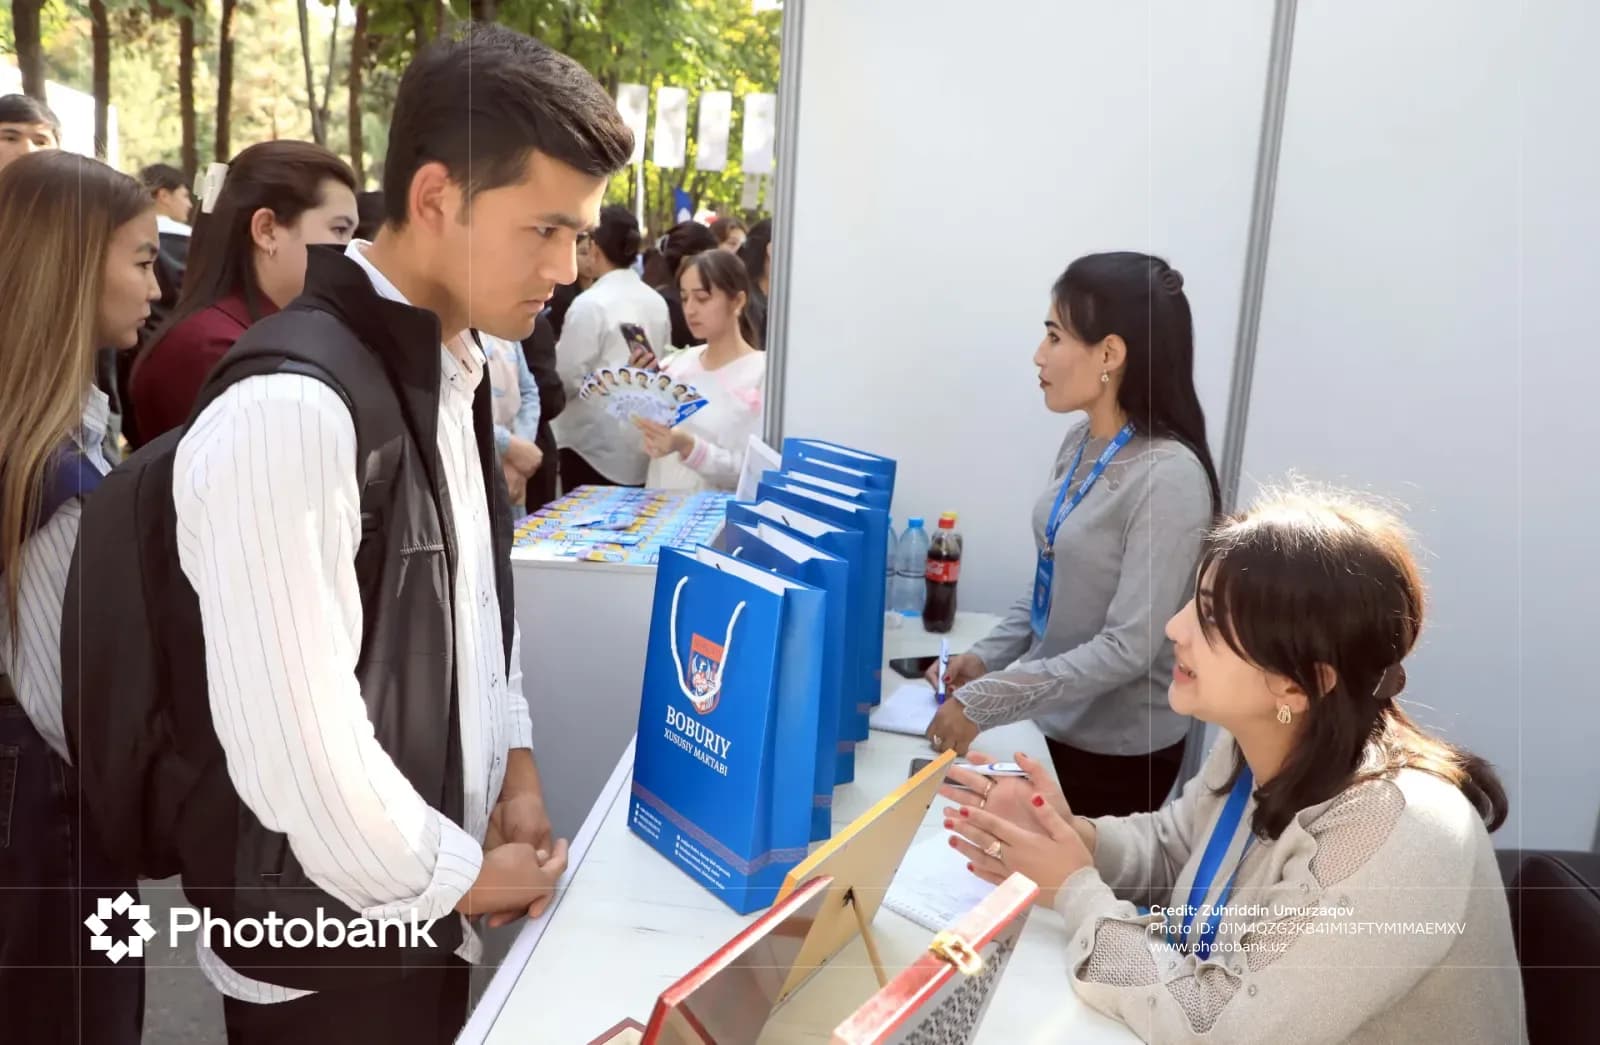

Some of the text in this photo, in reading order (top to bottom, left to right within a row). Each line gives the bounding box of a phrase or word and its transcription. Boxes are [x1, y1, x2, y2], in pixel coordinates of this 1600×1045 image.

[663, 727, 728, 777] XUSUSIY MAKTABI
[665, 704, 732, 760] BOBURIY
